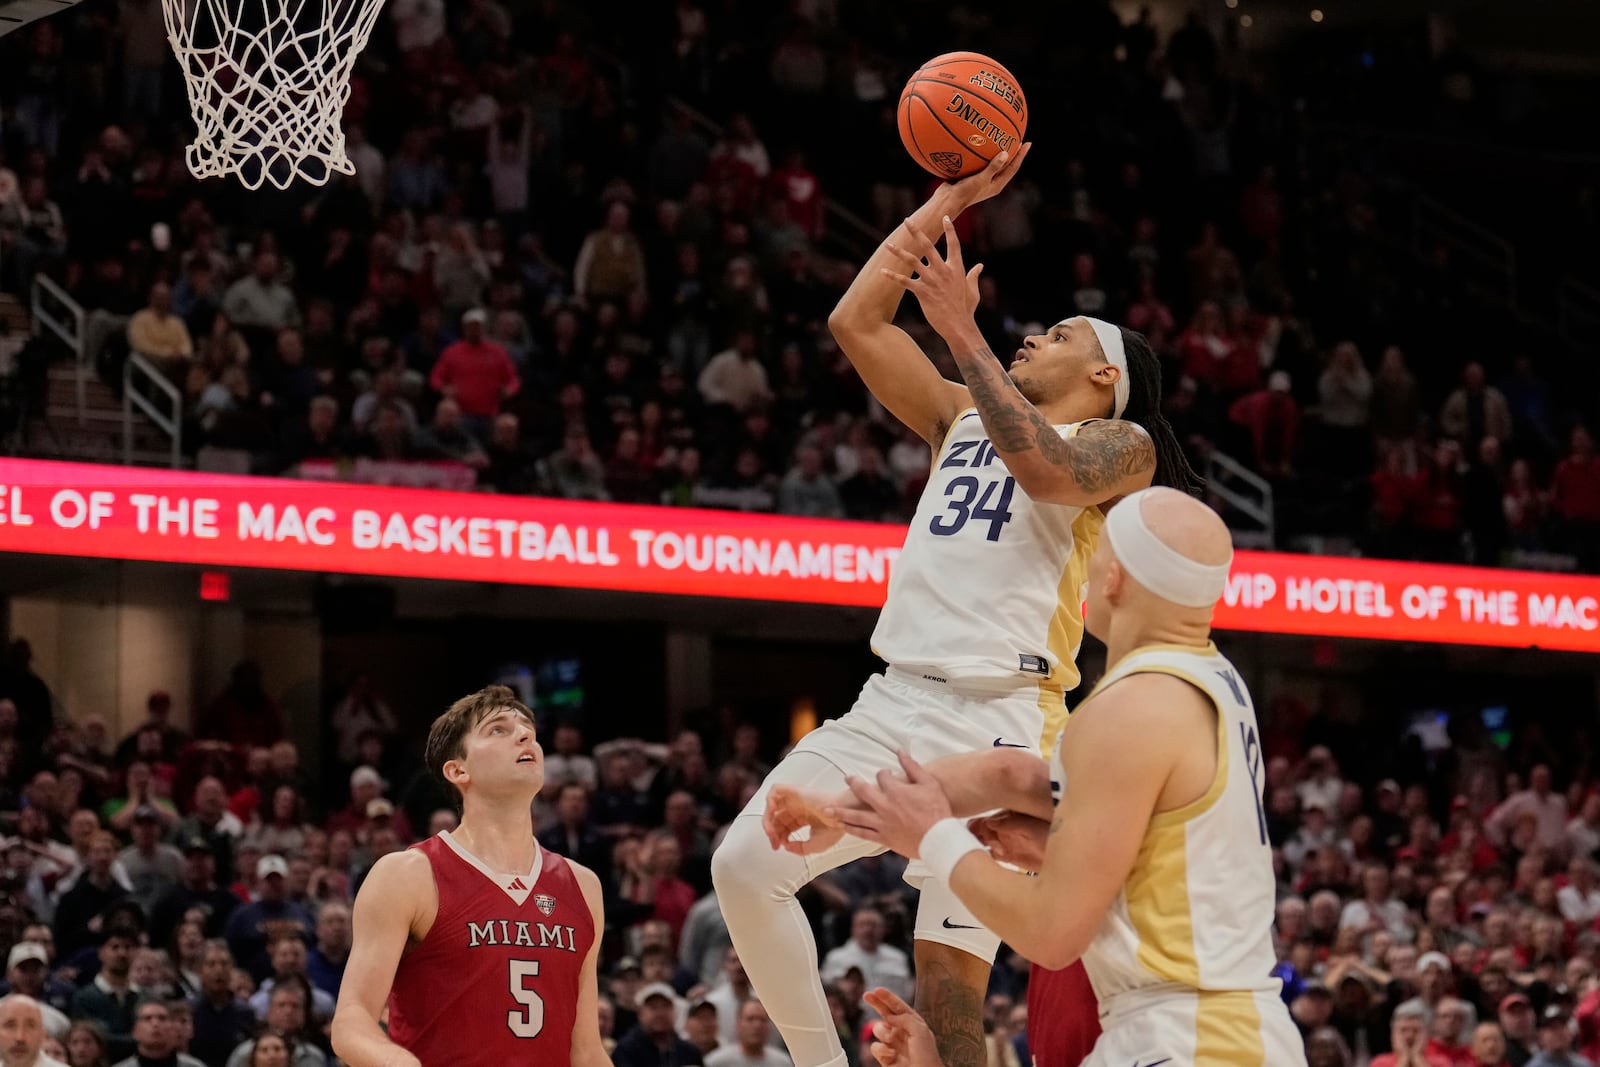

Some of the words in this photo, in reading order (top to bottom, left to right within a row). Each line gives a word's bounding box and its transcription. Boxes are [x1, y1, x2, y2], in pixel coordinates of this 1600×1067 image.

[50, 489, 114, 530] OF
[129, 494, 220, 538] THE
[237, 501, 336, 546] MAC
[352, 510, 620, 566] BASKETBALL
[629, 529, 902, 583] TOURNAMENT
[929, 475, 1016, 542] 34
[1223, 572, 1277, 608] VIP
[1285, 576, 1394, 617] HOTEL
[1401, 584, 1448, 621] OF
[1454, 587, 1520, 626] THE
[1528, 593, 1599, 631] MAC
[922, 674, 947, 683] AKRON
[468, 920, 577, 952] MIAMI
[507, 959, 544, 1038] 5
